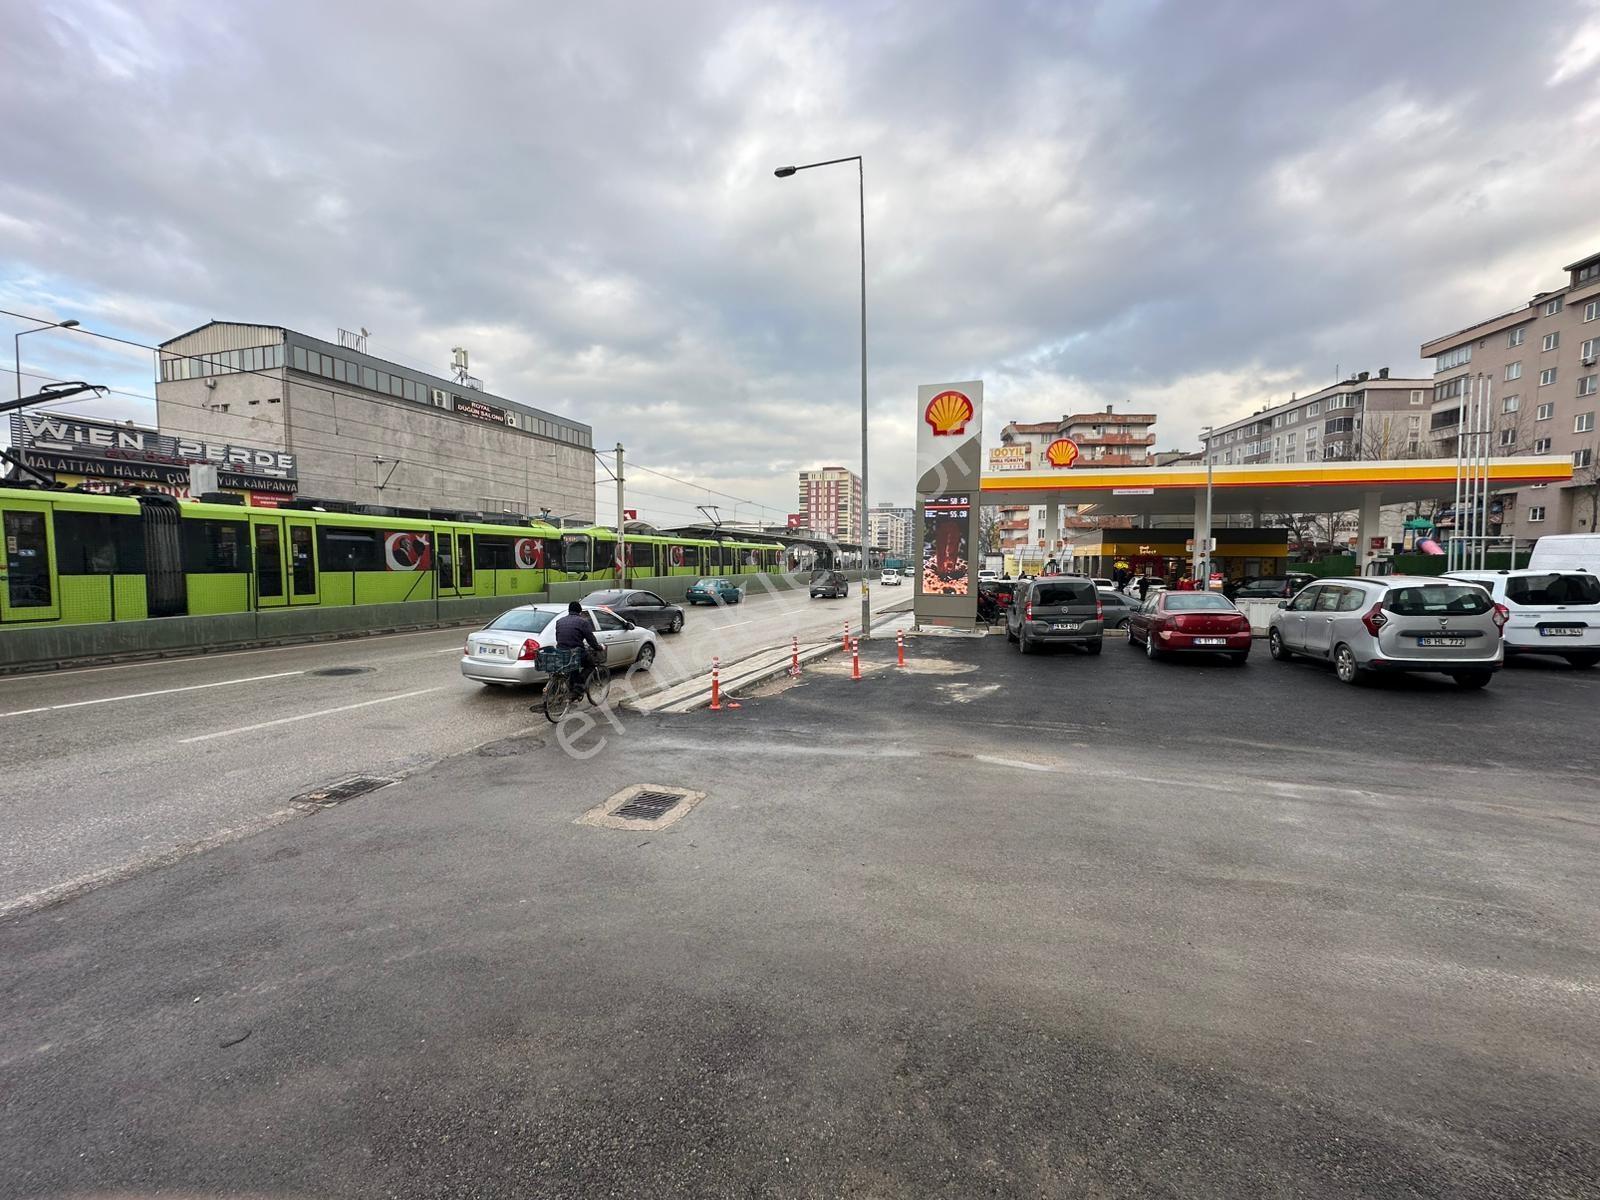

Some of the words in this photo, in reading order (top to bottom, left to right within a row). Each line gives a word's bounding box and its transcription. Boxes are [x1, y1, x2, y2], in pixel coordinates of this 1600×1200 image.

[177, 440, 295, 469] PERDE
[113, 465, 159, 480] HALKA
[243, 477, 298, 492] KAMPANYA
